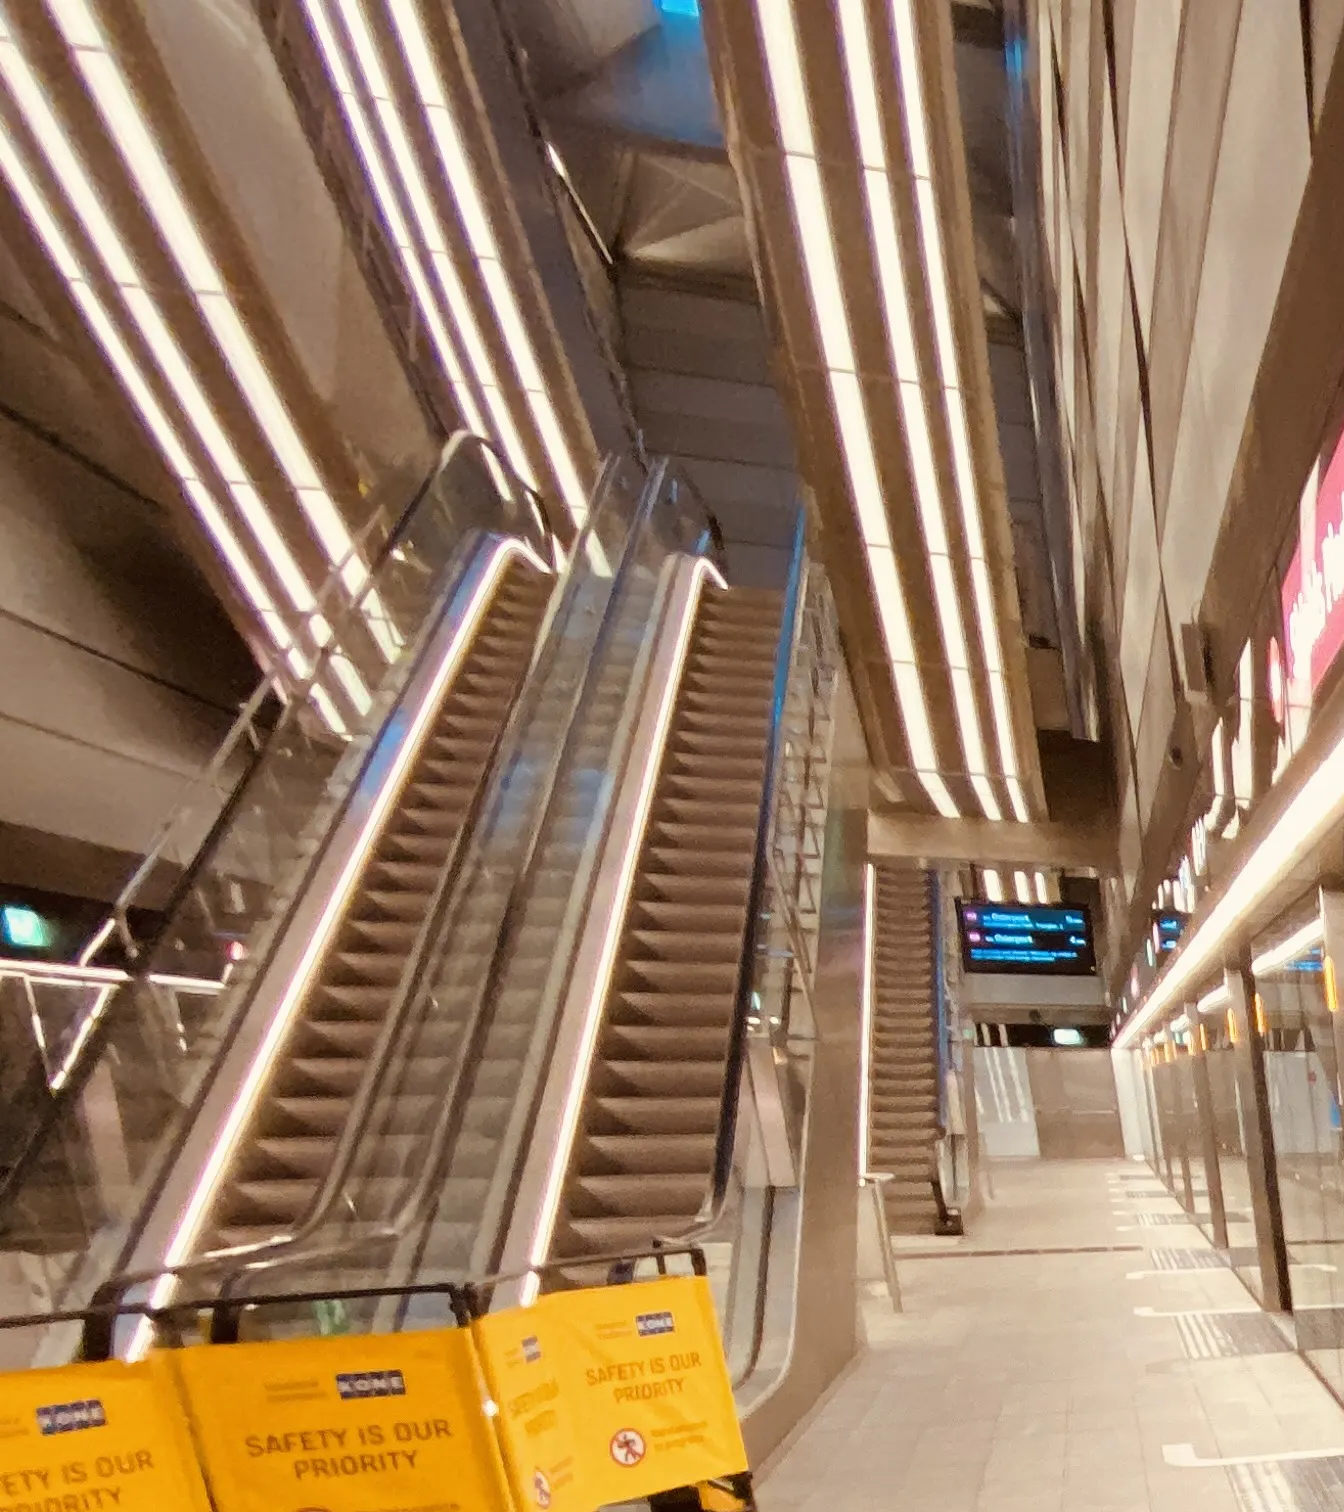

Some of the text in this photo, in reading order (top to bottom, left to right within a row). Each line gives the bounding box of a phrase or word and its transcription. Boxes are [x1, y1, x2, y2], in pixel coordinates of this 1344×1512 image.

[585, 1351, 702, 1386] SAFETY IS OUR
[613, 1377, 686, 1403] PRIORITY
[245, 1419, 452, 1457] SAFETY IS OUR
[61, 1462, 87, 1484] IS
[95, 1449, 154, 1478] OUR
[293, 1450, 418, 1480] PRIORITY
